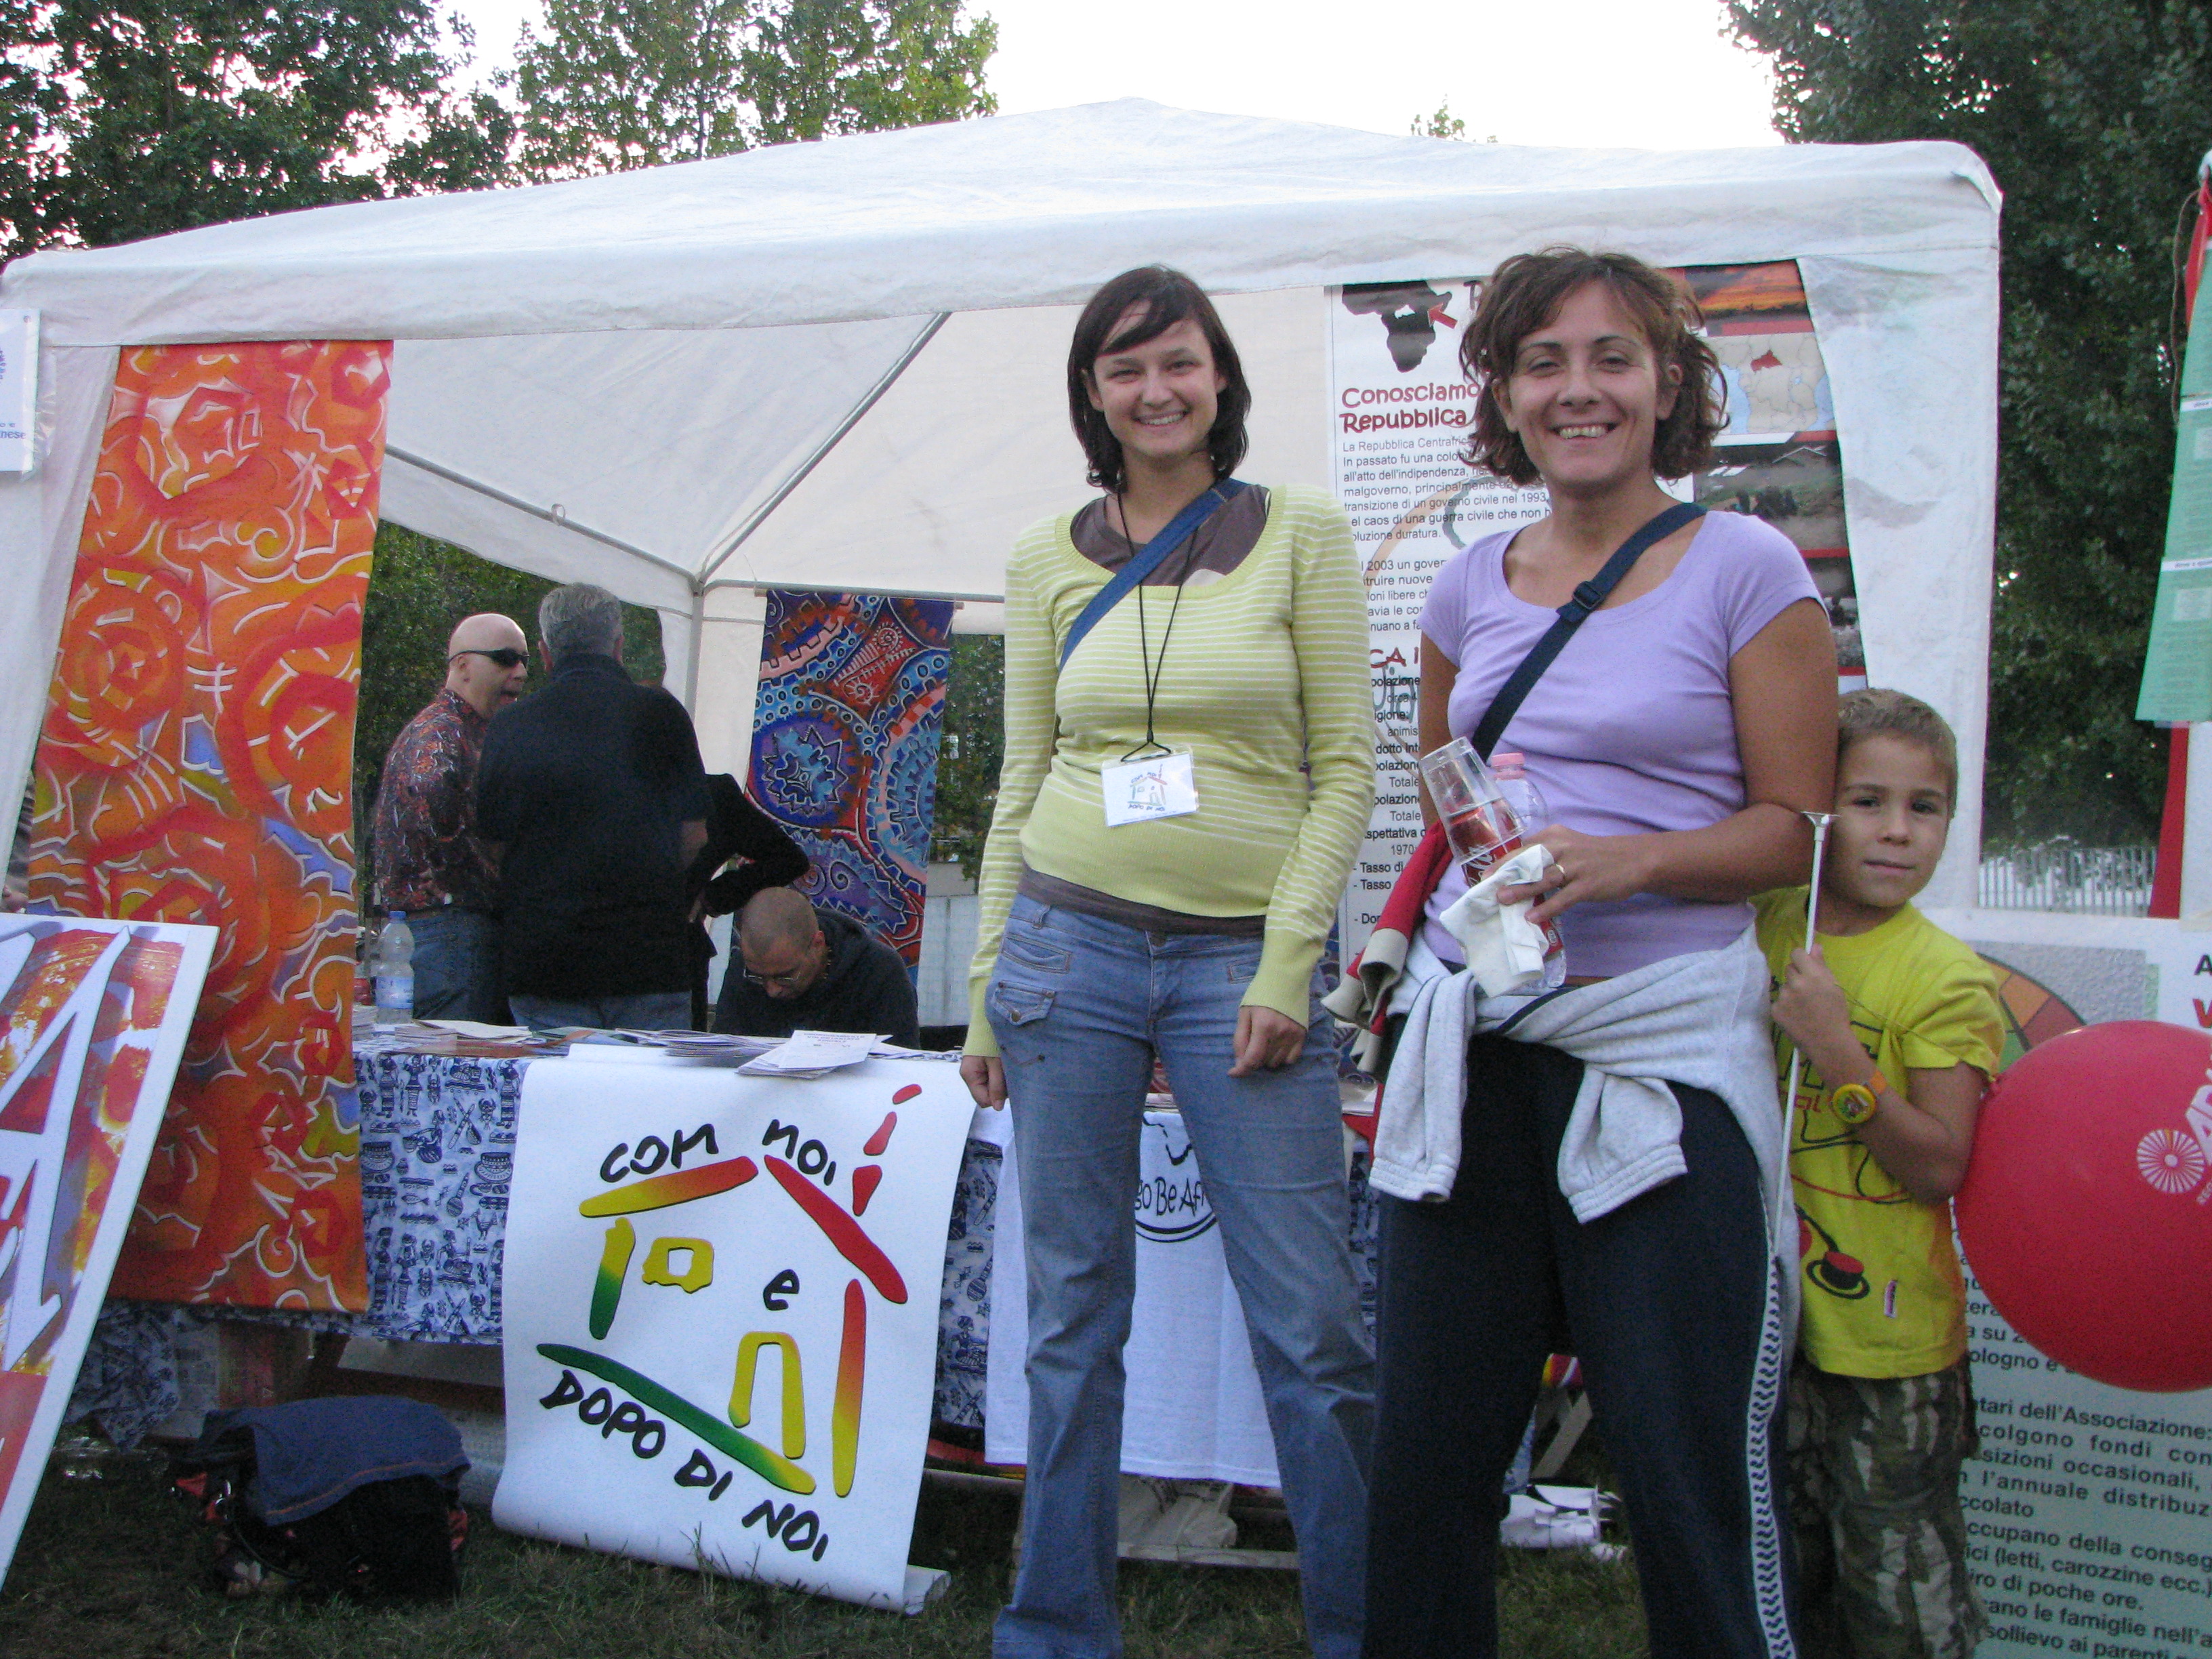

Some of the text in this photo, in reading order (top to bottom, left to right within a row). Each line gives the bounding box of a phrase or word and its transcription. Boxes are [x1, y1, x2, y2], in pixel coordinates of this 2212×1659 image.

[1341, 382, 1481, 409] Conosciamo
[1339, 407, 1467, 434] Repubblica
[1343, 442, 1355, 452] La
[1358, 439, 1414, 453] Repubblica
[1343, 457, 1353, 467] In
[1356, 454, 1397, 469] passato
[1400, 453, 1410, 464] fu
[1414, 453, 1433, 464] una
[1343, 470, 1376, 482] all'atto
[1378, 467, 1469, 480] dell'indipendenza,
[1344, 483, 1412, 498] malgoverno,
[1345, 501, 1399, 512] transizione
[1401, 499, 1411, 510] di
[1414, 499, 1427, 509] un
[1473, 493, 1499, 506] civile
[1502, 493, 1517, 504] nel
[1351, 516, 1361, 527] el
[1364, 516, 1389, 527] caos
[1393, 513, 1402, 524] di
[1406, 513, 1426, 524] una
[1429, 512, 1464, 526] guerra
[1467, 510, 1494, 521] civile
[1498, 509, 1517, 520] che
[1521, 509, 1541, 518] non
[1353, 527, 1441, 541] oluzione duratura.
[1367, 560, 1394, 571] 2003
[1397, 561, 1410, 570] un
[1414, 559, 1447, 571] gover
[1363, 575, 1433, 586] truire nuove
[1388, 590, 1416, 600] libere
[1393, 605, 1403, 615] le
[1370, 621, 1401, 632] nuano
[1371, 675, 1420, 687] polazione
[1387, 725, 1418, 737] animis
[1376, 743, 1402, 755] dotto
[1389, 776, 1420, 787] Totale
[1390, 810, 1421, 821] Totale
[1365, 827, 1417, 841] spettativa
[1359, 861, 1404, 873] Tasso di
[1359, 879, 1391, 890] Tasso
[1982, 1326, 2006, 1341] su
[1969, 1347, 2039, 1370] ologno
[1976, 1397, 2013, 1416] tari
[1978, 1423, 2074, 1448] colgono
[2090, 1434, 2152, 1458] fondi
[539, 1369, 828, 1562] DOPO DI NOI
[1981, 1447, 2053, 1471] sizioni
[1967, 1521, 2212, 1573] ccupano della conseg
[2051, 1558, 2155, 1586] carozzine
[2003, 1572, 2022, 1593] di
[2028, 1581, 2095, 1603] poche
[2102, 1593, 2144, 1612] ore.
[2034, 1602, 2053, 1622] le
[2059, 1606, 2147, 1638] famiglie
[2069, 1636, 2089, 1654] ai
